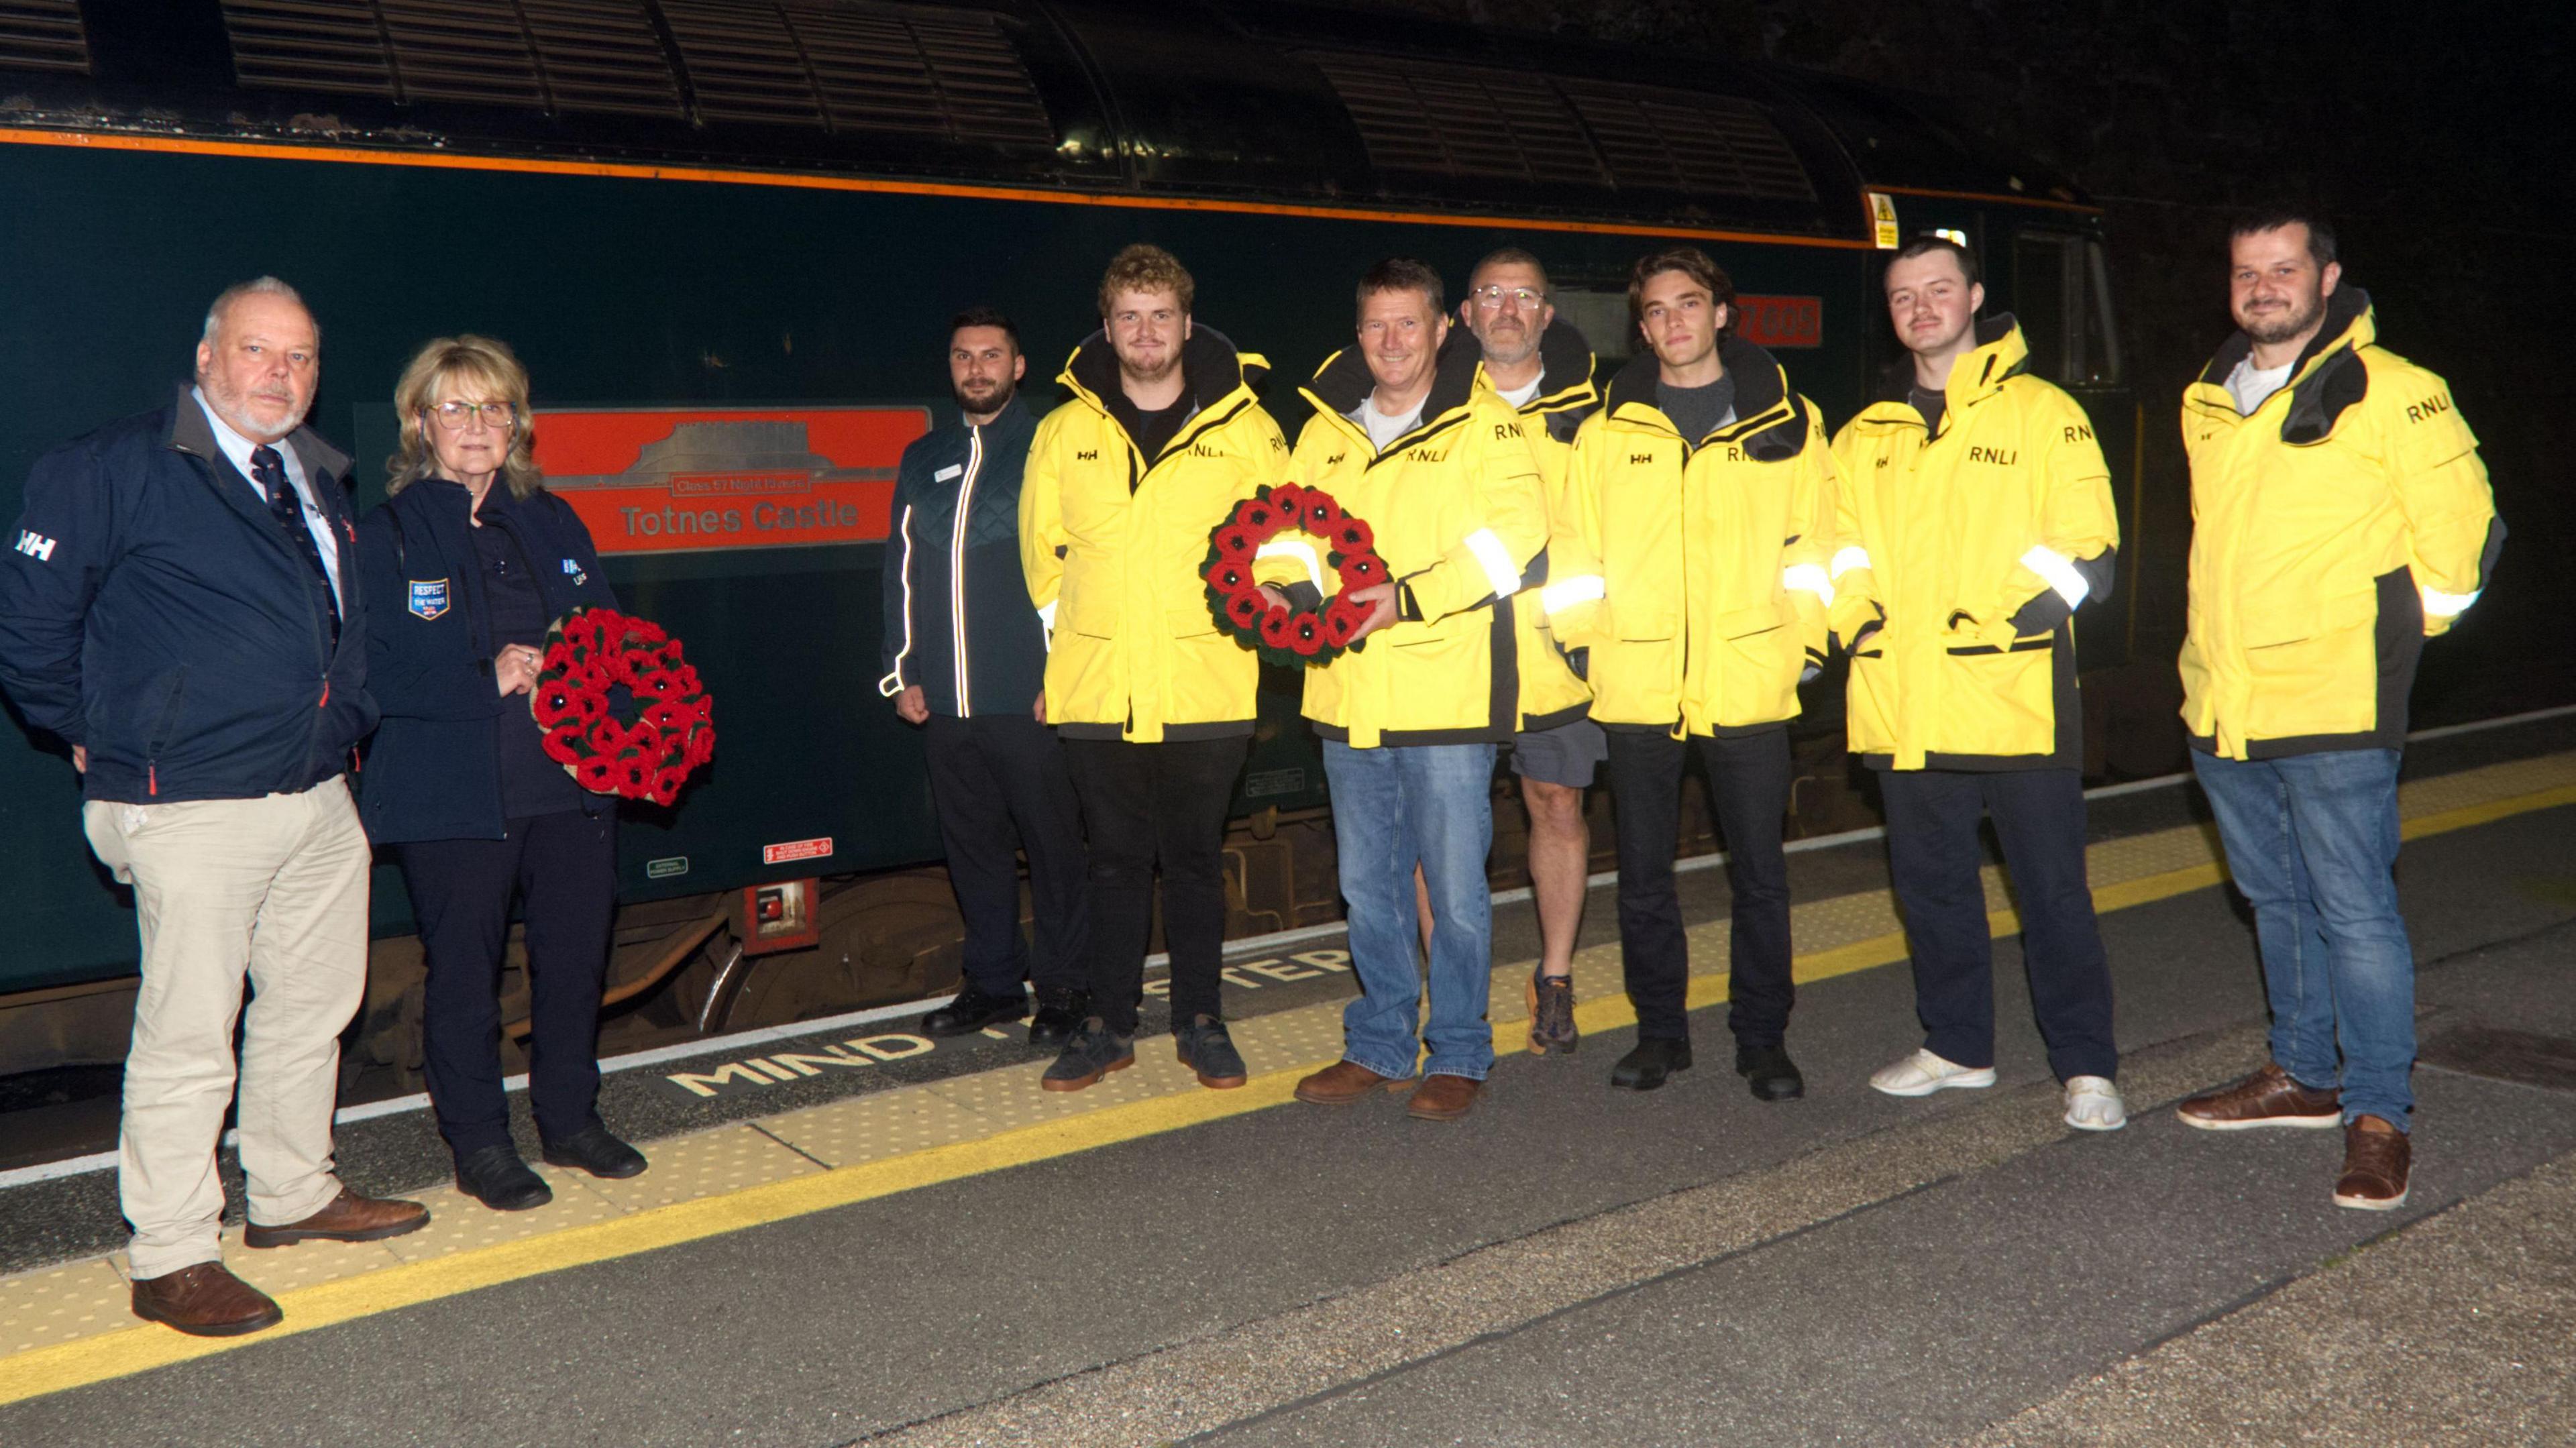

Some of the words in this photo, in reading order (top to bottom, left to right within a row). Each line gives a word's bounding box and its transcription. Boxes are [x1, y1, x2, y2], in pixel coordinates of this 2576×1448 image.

[1740, 305, 1815, 337] 7605
[2407, 392, 2451, 424] RNLI
[2064, 425, 2092, 443] RN
[1077, 450, 1098, 461] HH
[1405, 449, 1448, 462] RNLI
[1630, 454, 1652, 464] HH
[1969, 447, 2017, 465] RNLI
[620, 504, 743, 536] Totnes
[751, 499, 859, 531] Castle
[15, 529, 56, 561] HH
[414, 583, 445, 596] RESPECT
[665, 1034, 935, 1097] MIND
